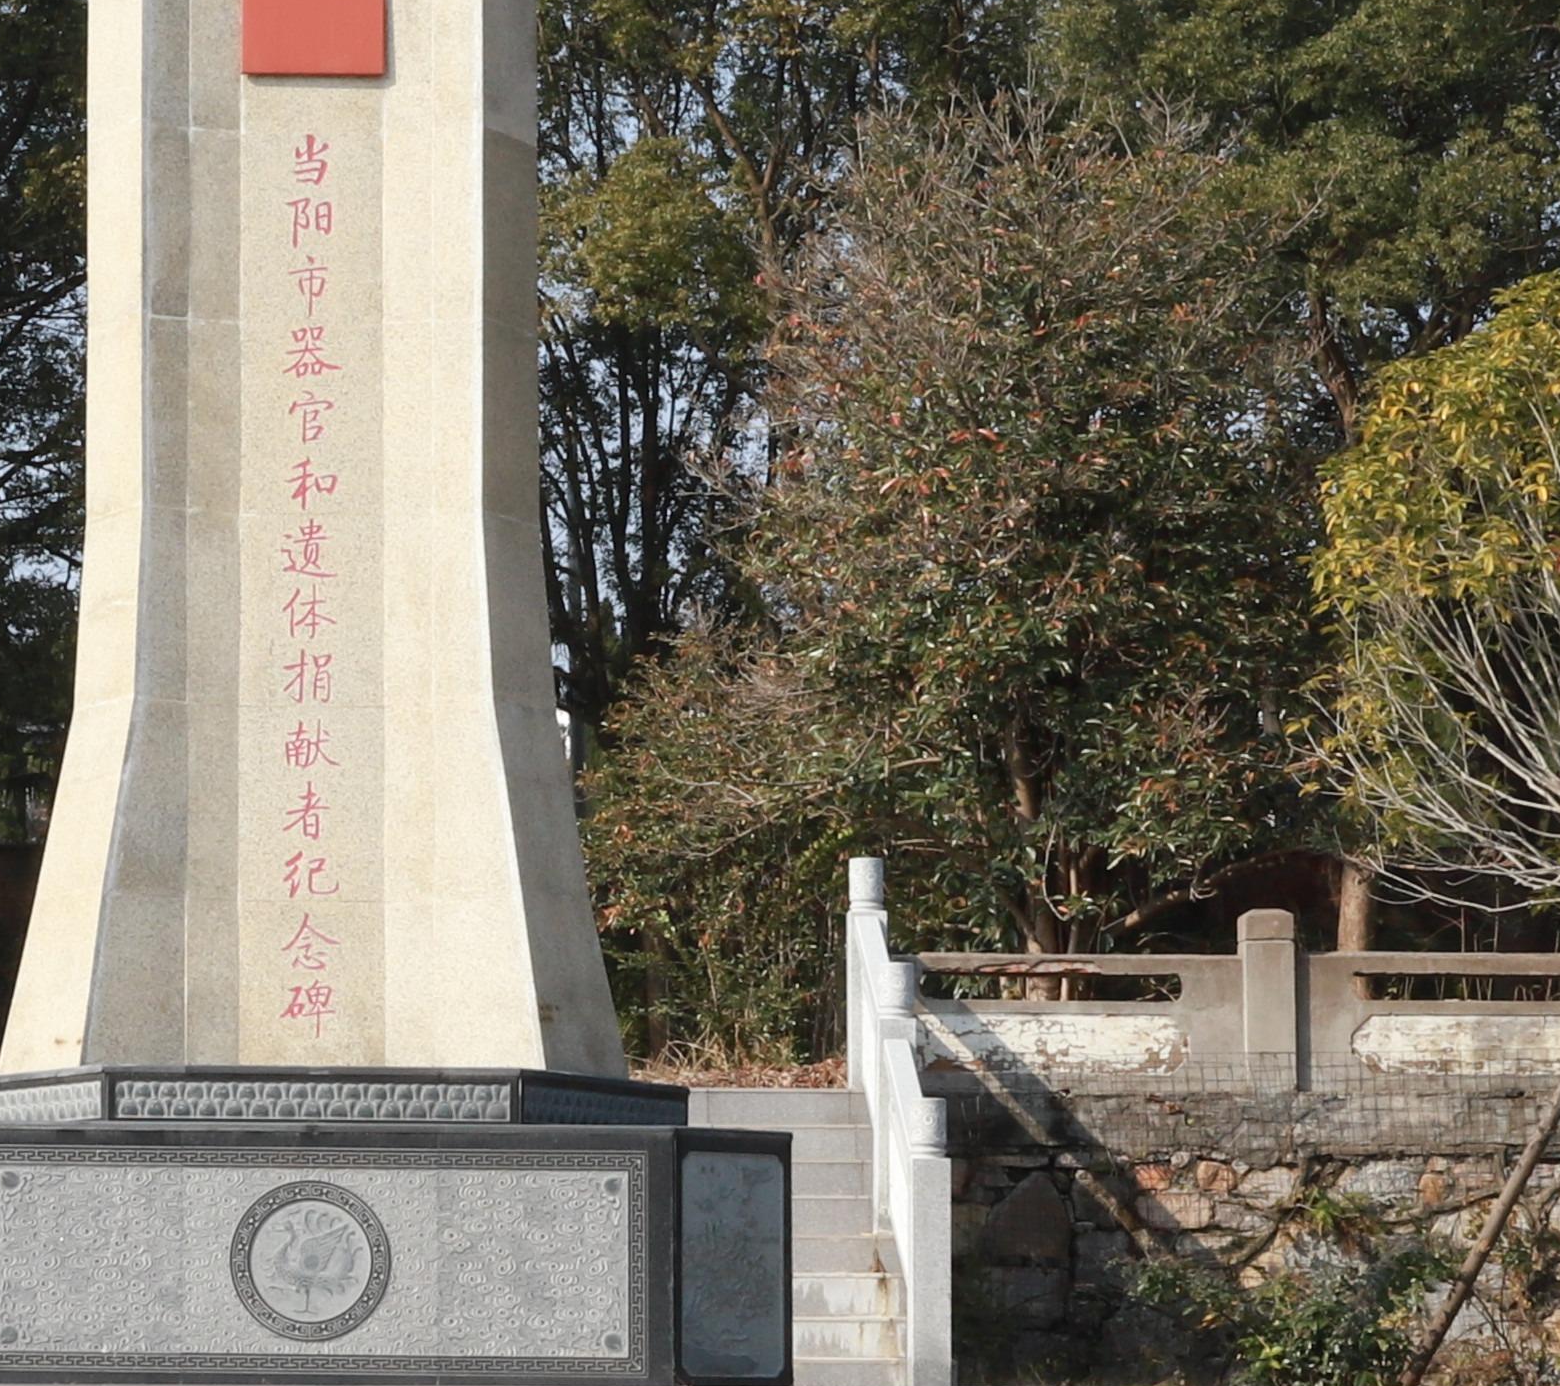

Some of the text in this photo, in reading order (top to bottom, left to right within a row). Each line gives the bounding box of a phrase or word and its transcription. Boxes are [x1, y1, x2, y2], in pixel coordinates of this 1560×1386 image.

[279, 134, 341, 1039] 当阳市器官和遗体捐献者纪念碑
